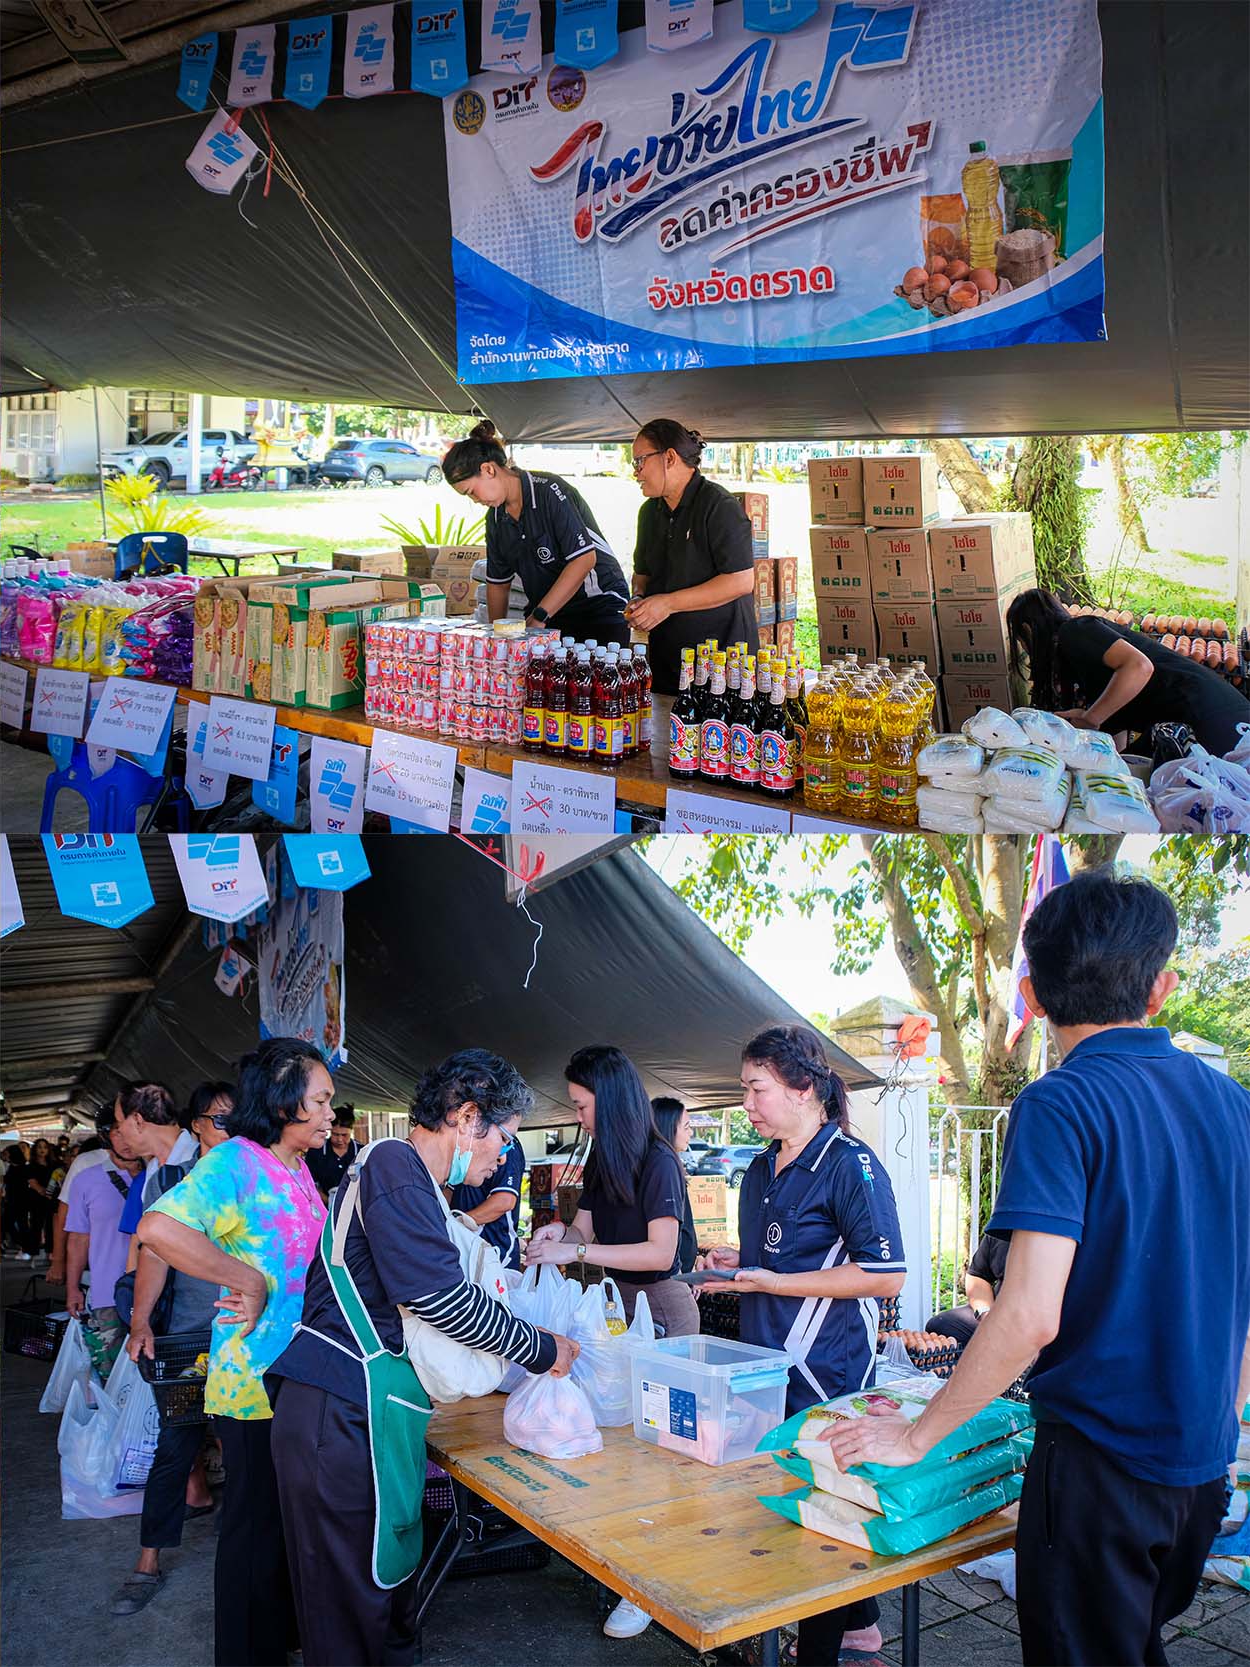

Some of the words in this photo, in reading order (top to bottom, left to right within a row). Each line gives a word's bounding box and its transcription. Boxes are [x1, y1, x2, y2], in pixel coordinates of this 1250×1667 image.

[416, 9, 458, 34] DiT
[668, 18, 690, 31] DiT
[293, 30, 326, 50] DiT
[186, 42, 213, 56] DiT
[492, 76, 538, 110] DiT
[495, 102, 538, 119] กรมการค้าภายใน
[529, 37, 836, 243] ไทยช่วยไทย
[648, 265, 835, 312] จังหวัดตราด
[469, 333, 506, 348] จัดโดย
[471, 342, 630, 366] สำนักงานพาณิชย์จังหวัดตราด
[828, 465, 849, 478] ไชโย
[883, 465, 905, 479] ไชโย
[828, 536, 850, 549] ไชโย
[888, 540, 911, 553] ไชโย
[952, 535, 976, 548] ไชโย
[834, 605, 856, 619] ไชโย
[958, 609, 982, 623] ไชโย
[894, 613, 916, 626] ไชโย
[966, 685, 991, 699] ไชโย
[530, 775, 556, 793] น้ำปลา
[562, 787, 600, 801] ตราทิพรส
[371, 784, 396, 798] ลดเหลือ
[397, 790, 407, 801] 15
[408, 795, 449, 813] บาท/กระป๋อง
[480, 793, 508, 811] ธงฟ้า
[559, 804, 571, 814] 30
[572, 807, 609, 823] บาท/ขวด
[676, 809, 742, 830] ซอสหอยนางรม
[60, 848, 126, 861] กรมการค้าภายใน
[211, 878, 237, 892] DiT
